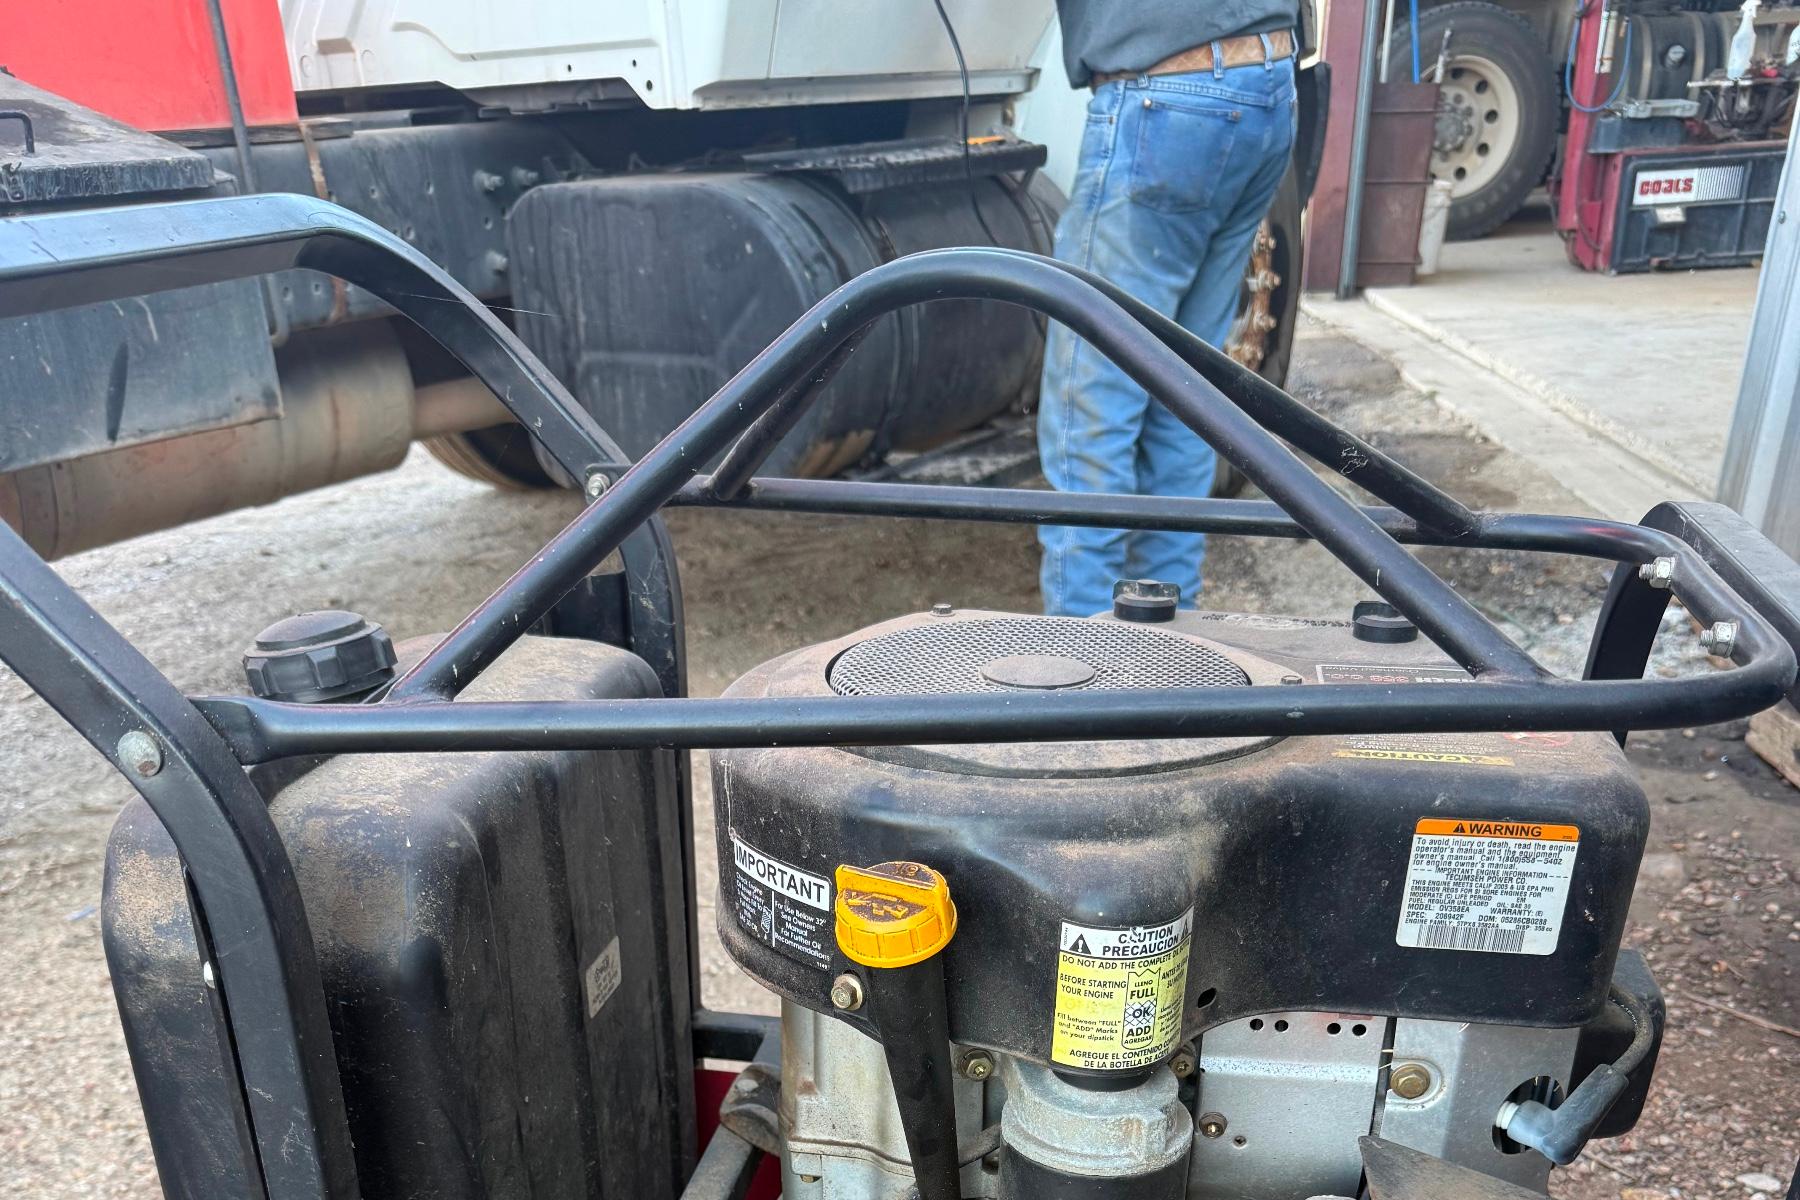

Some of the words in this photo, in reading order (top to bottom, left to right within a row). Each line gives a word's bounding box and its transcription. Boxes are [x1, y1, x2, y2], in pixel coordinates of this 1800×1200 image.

[1469, 823, 1542, 837] WARNING
[1415, 844, 1454, 853] operator's
[1456, 846, 1484, 854] manual
[1518, 850, 1560, 860] equipment
[1451, 839, 1473, 847] injury
[1548, 844, 1575, 852] engine
[1426, 859, 1451, 867] engine
[1454, 860, 1485, 868] owner's
[1487, 862, 1518, 870] manual.
[736, 842, 825, 902] IMPORTANT
[1445, 873, 1483, 882] TECUMSEH
[775, 900, 783, 910] For
[784, 905, 795, 915] Use
[796, 909, 814, 923] Below
[1490, 908, 1533, 916] WARRANTY:
[781, 911, 791, 922] See
[792, 918, 816, 932] Owners
[785, 922, 808, 936] Manual
[781, 928, 790, 938] For
[812, 941, 821, 949] Oil
[1102, 933, 1179, 956] PRECAUCION
[775, 932, 830, 961] Recommendations
[1062, 955, 1075, 964] DO
[1077, 959, 1095, 968] NOT
[1138, 953, 1172, 968] COMPLETE
[1060, 973, 1086, 986] BEFORE
[1088, 977, 1127, 989] STARTING
[1061, 984, 1082, 996] YOUR
[1084, 989, 1114, 999] ENGINE
[1129, 987, 1156, 1000] FULL
[1066, 1014, 1097, 1025] between
[1132, 1007, 1151, 1018] OK
[1058, 1021, 1071, 1029] and
[1126, 1025, 1151, 1037] ADD
[1070, 1031, 1086, 1040] your
[1087, 1033, 1114, 1041] dipstick
[1124, 1035, 1153, 1045] AGREGAR
[1069, 1049, 1109, 1060] AGREGUE
[1112, 1052, 1120, 1060] EL
[1122, 1044, 1162, 1059] CONTENIDO
[1084, 1060, 1094, 1068] DE
[1110, 1056, 1142, 1068] BOTELLA
[1144, 1053, 1152, 1063] DE
